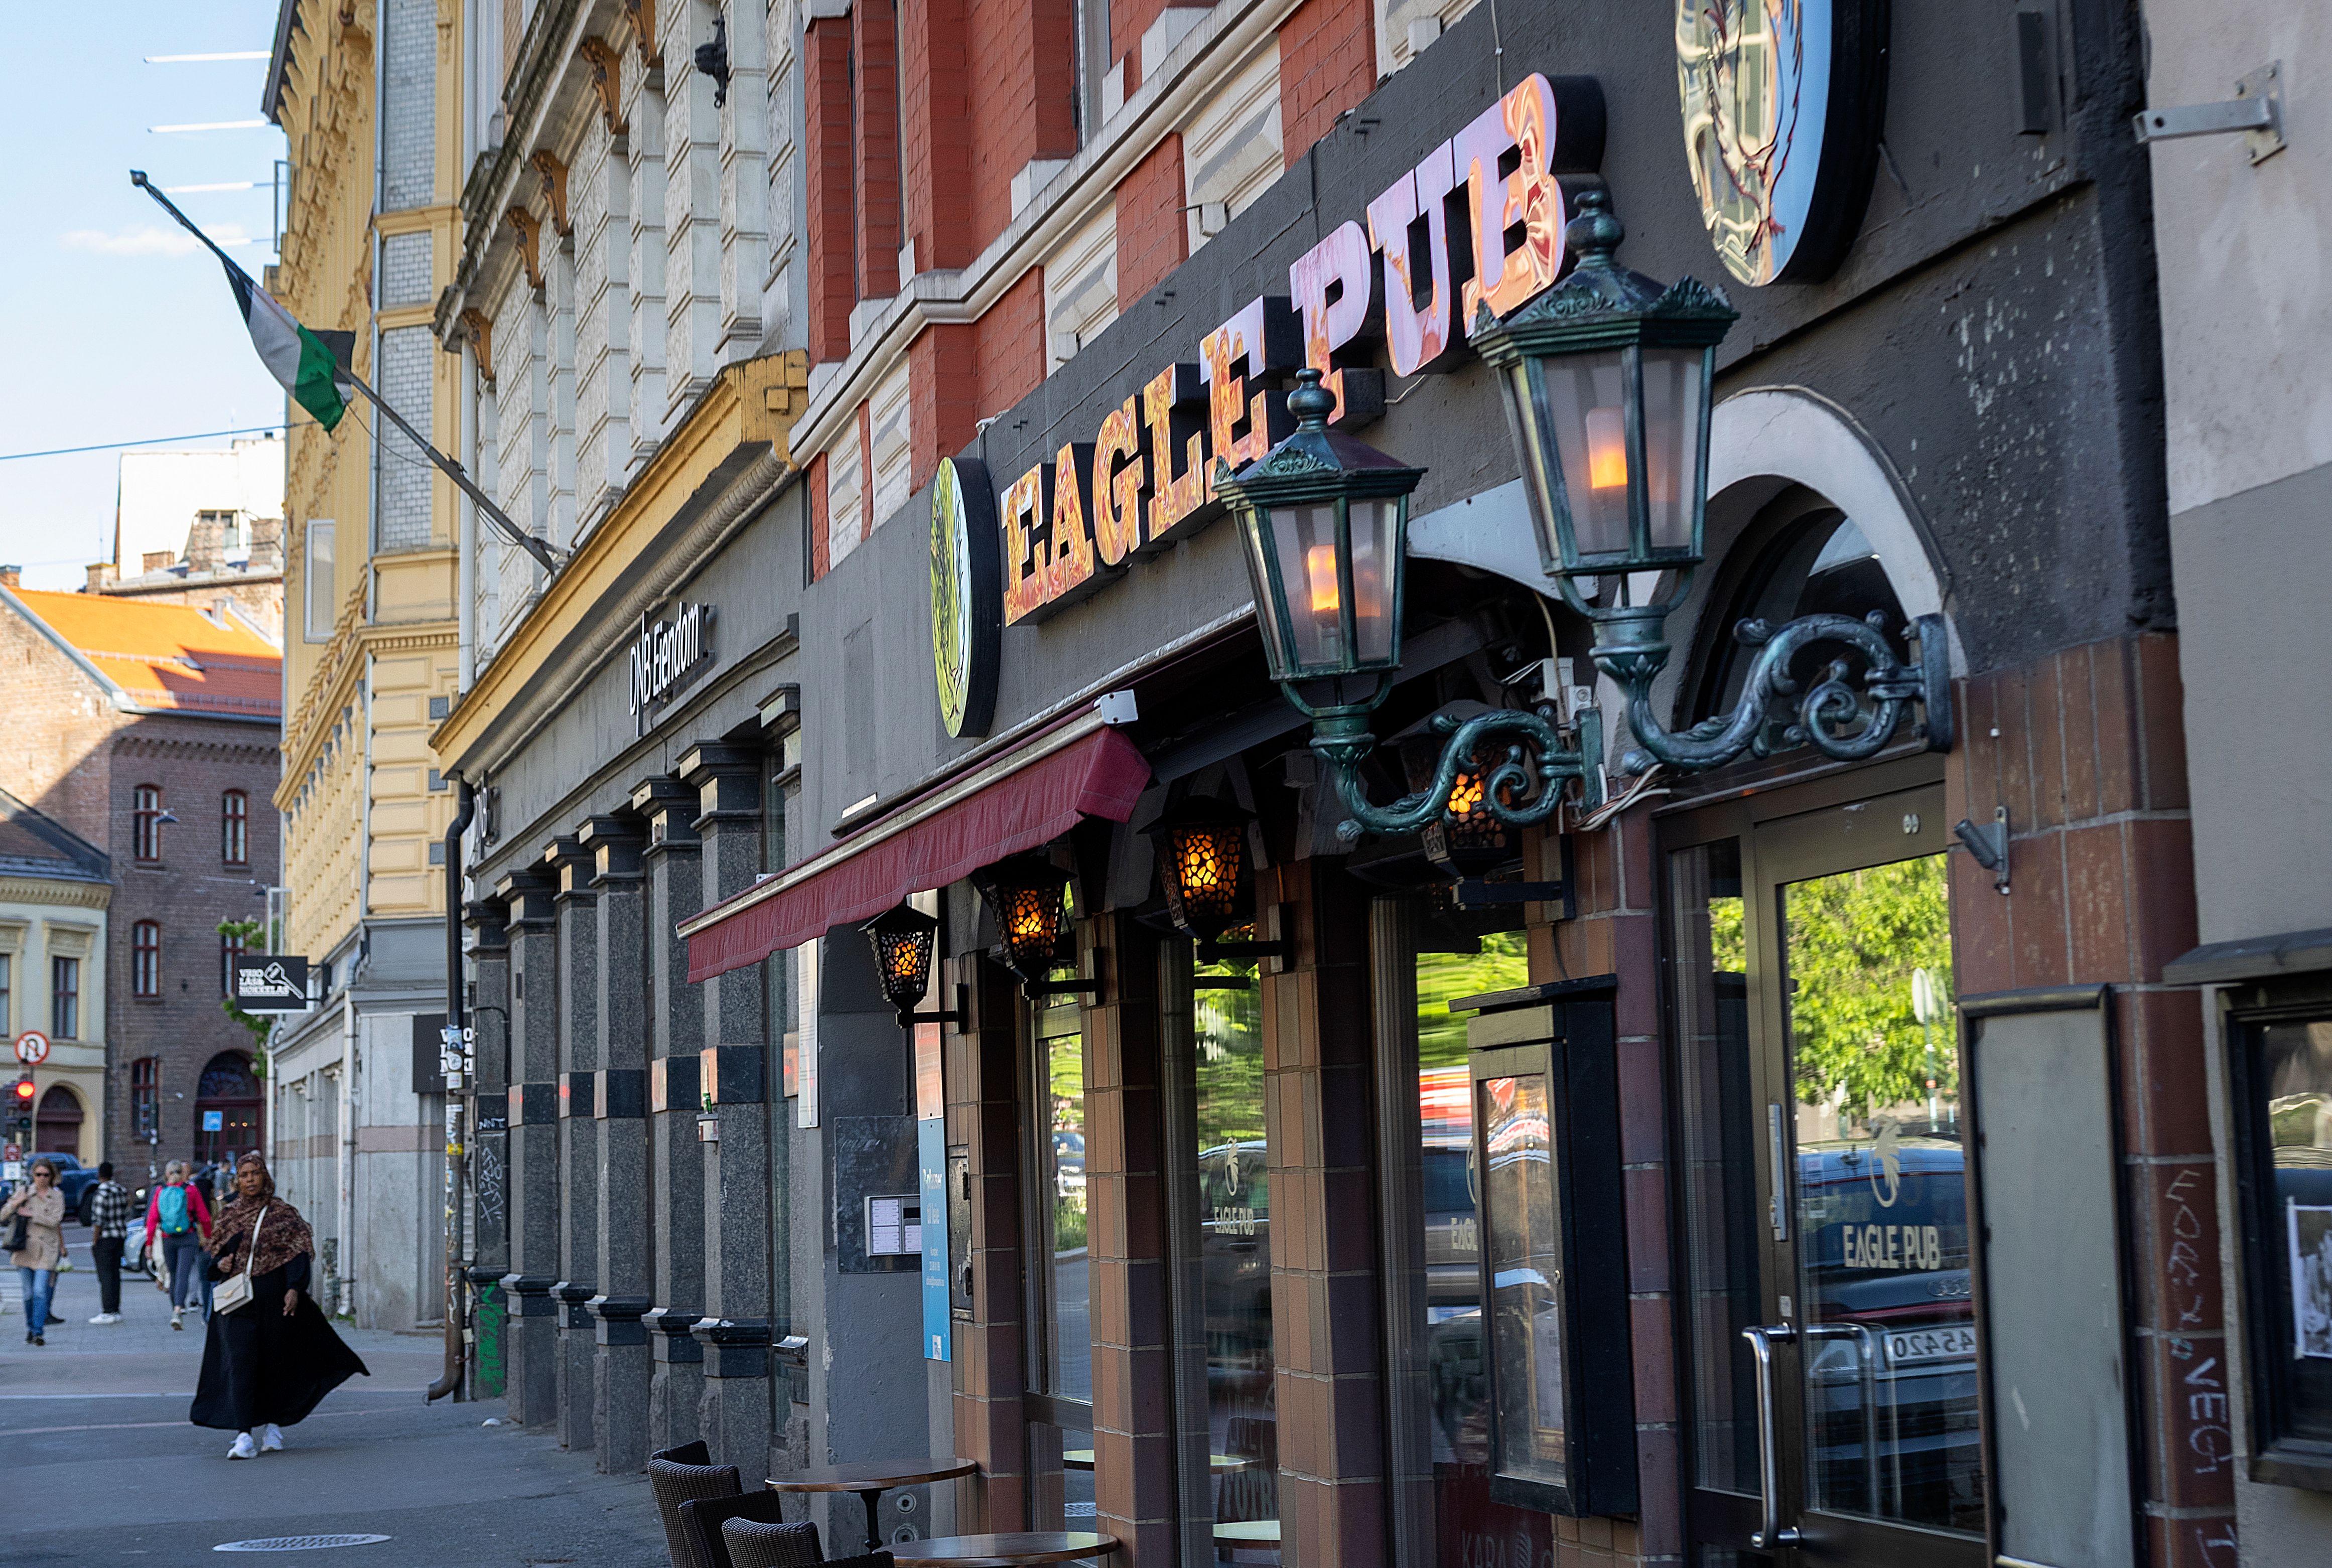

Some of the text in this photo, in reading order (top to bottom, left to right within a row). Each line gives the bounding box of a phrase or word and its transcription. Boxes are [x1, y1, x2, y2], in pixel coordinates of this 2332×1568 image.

[1000, 72, 1566, 627] EAGLE PUB
[629, 601, 699, 738] DNB Eiendom
[1214, 1206, 1255, 1235] EAGLE PUB
[1843, 1224, 1941, 1270] EAGLE PUB
[1224, 1468, 1279, 1521] FOTB
